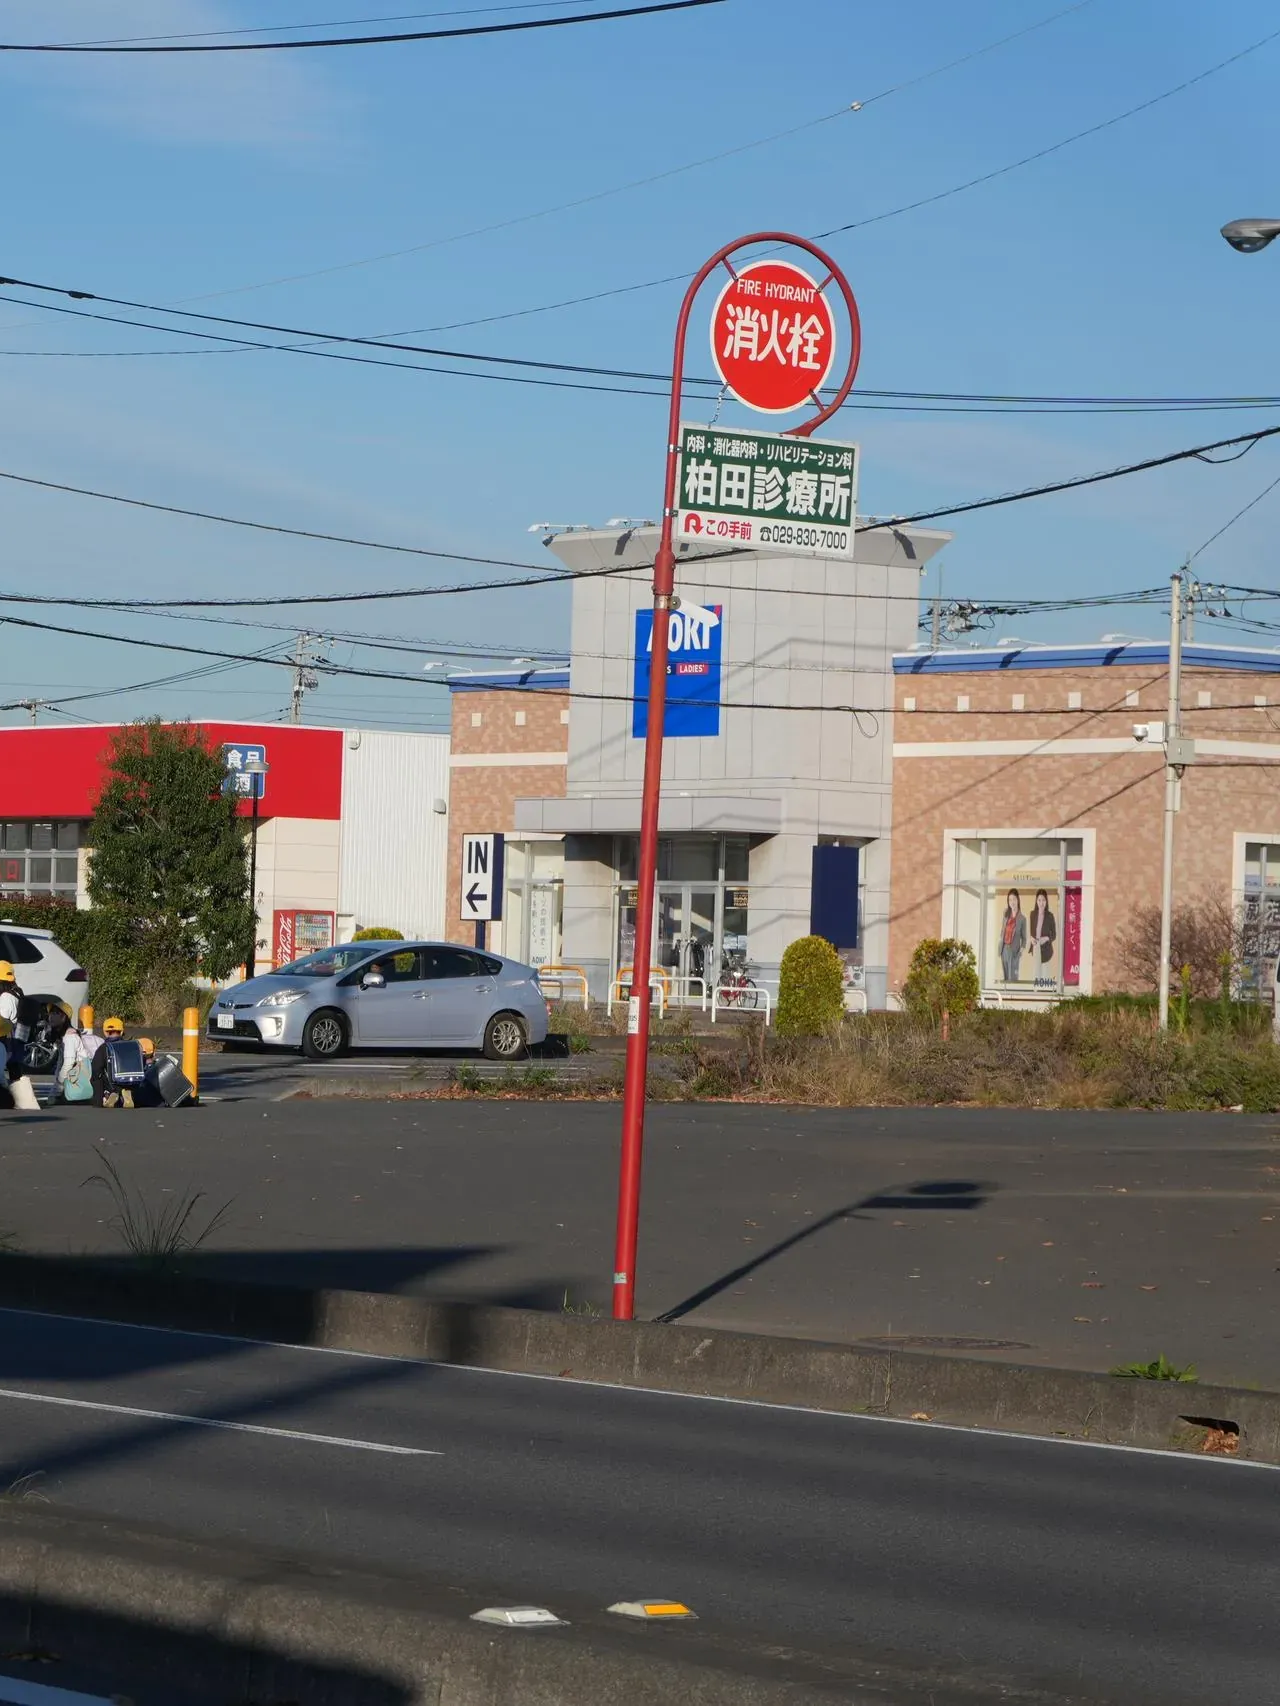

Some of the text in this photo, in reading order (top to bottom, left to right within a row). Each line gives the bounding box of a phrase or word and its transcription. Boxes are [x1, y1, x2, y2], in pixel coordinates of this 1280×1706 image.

[737, 279, 817, 304] FIRE HYDRANT
[723, 303, 824, 371] 消火栓
[685, 458, 852, 520] 柏田診療所
[706, 519, 752, 541] この手前
[772, 525, 847, 550] 029-830-7000
[468, 841, 488, 873] IN
